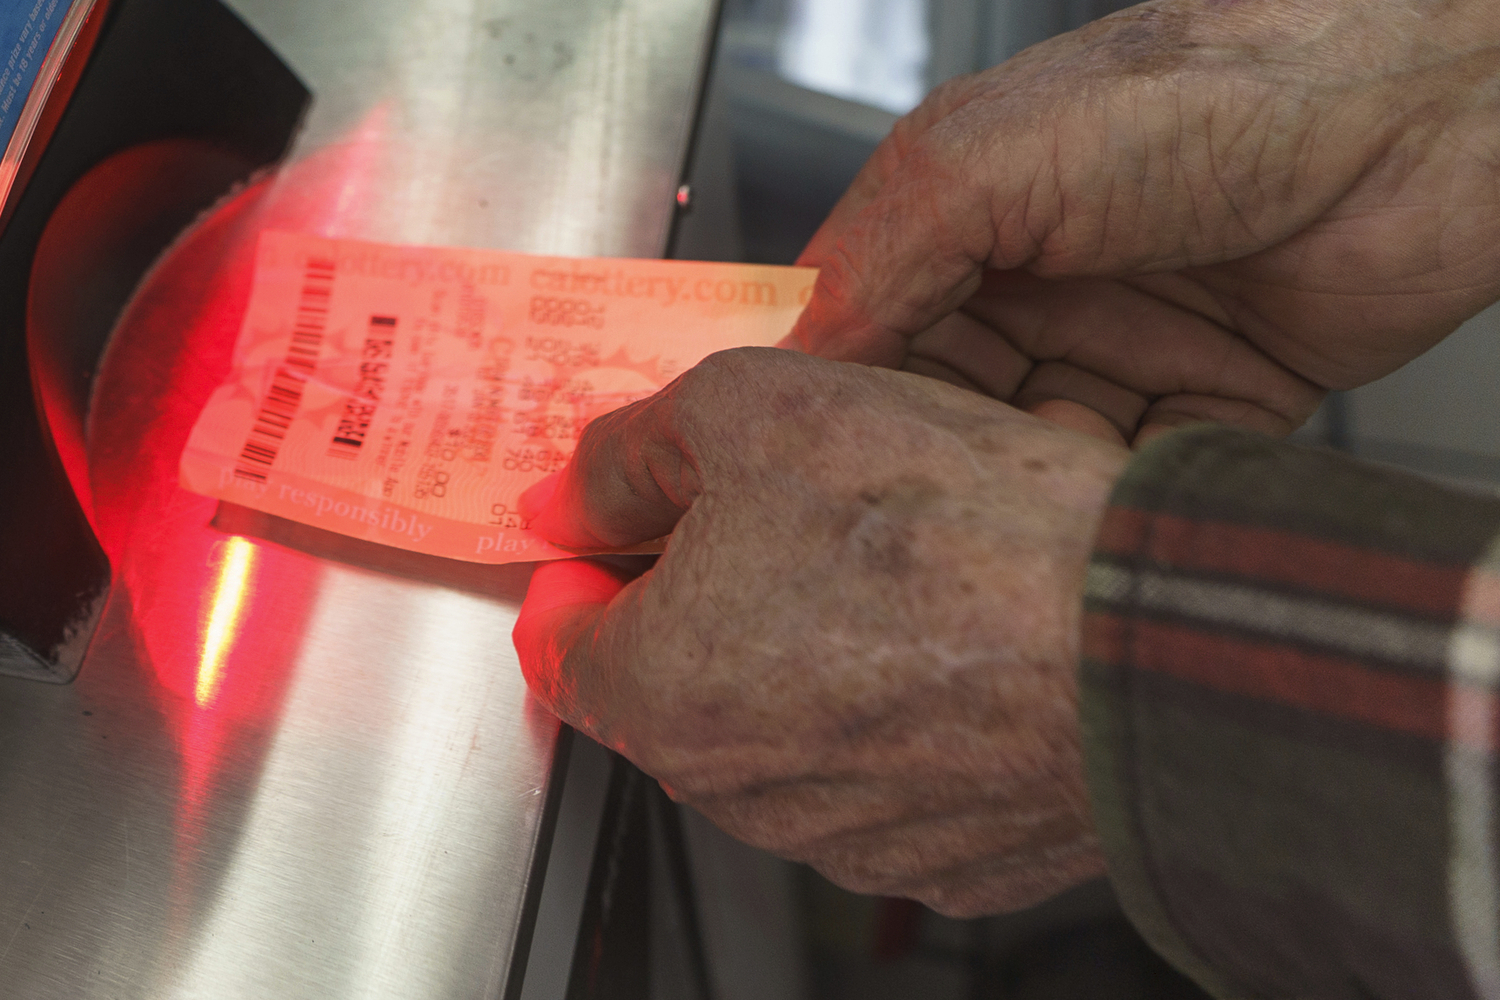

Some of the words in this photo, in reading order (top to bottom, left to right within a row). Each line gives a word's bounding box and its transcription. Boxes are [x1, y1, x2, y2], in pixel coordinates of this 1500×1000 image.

[0, 85, 16, 113] Must
[11, 72, 23, 86] be
[17, 57, 29, 70] 18
[25, 31, 41, 59] years
[37, 18, 47, 32] or
[5, 42, 22, 69] prize
[18, 19, 32, 43] vary
[529, 265, 780, 307] calottery.com
[278, 481, 434, 542] responsibly
[477, 532, 531, 554] play
